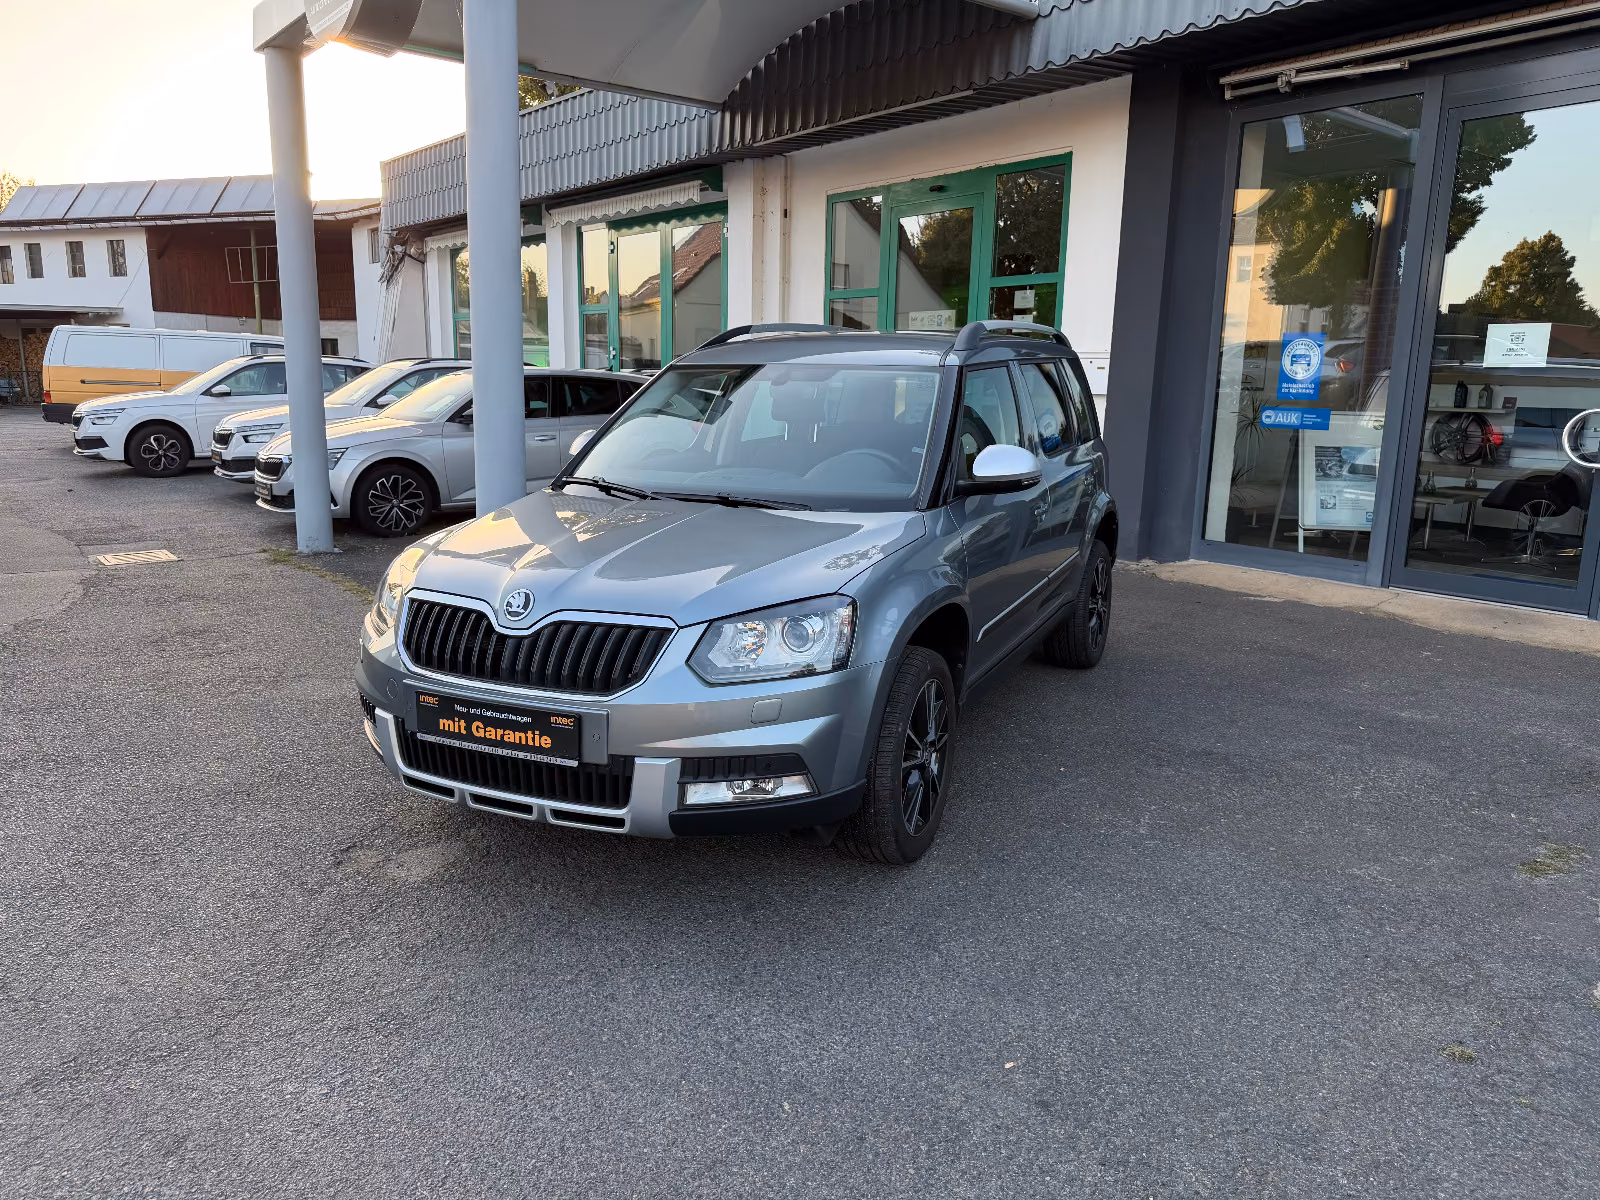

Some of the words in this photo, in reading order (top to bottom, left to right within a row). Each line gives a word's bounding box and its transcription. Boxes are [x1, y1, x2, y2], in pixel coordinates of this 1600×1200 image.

[419, 694, 439, 705] intec
[454, 703, 469, 713] Neu-
[469, 707, 480, 715] und
[481, 708, 532, 723] Gebrauchtwagen
[550, 716, 574, 726] intec
[439, 716, 467, 735] mit
[471, 720, 552, 748] Garantie
